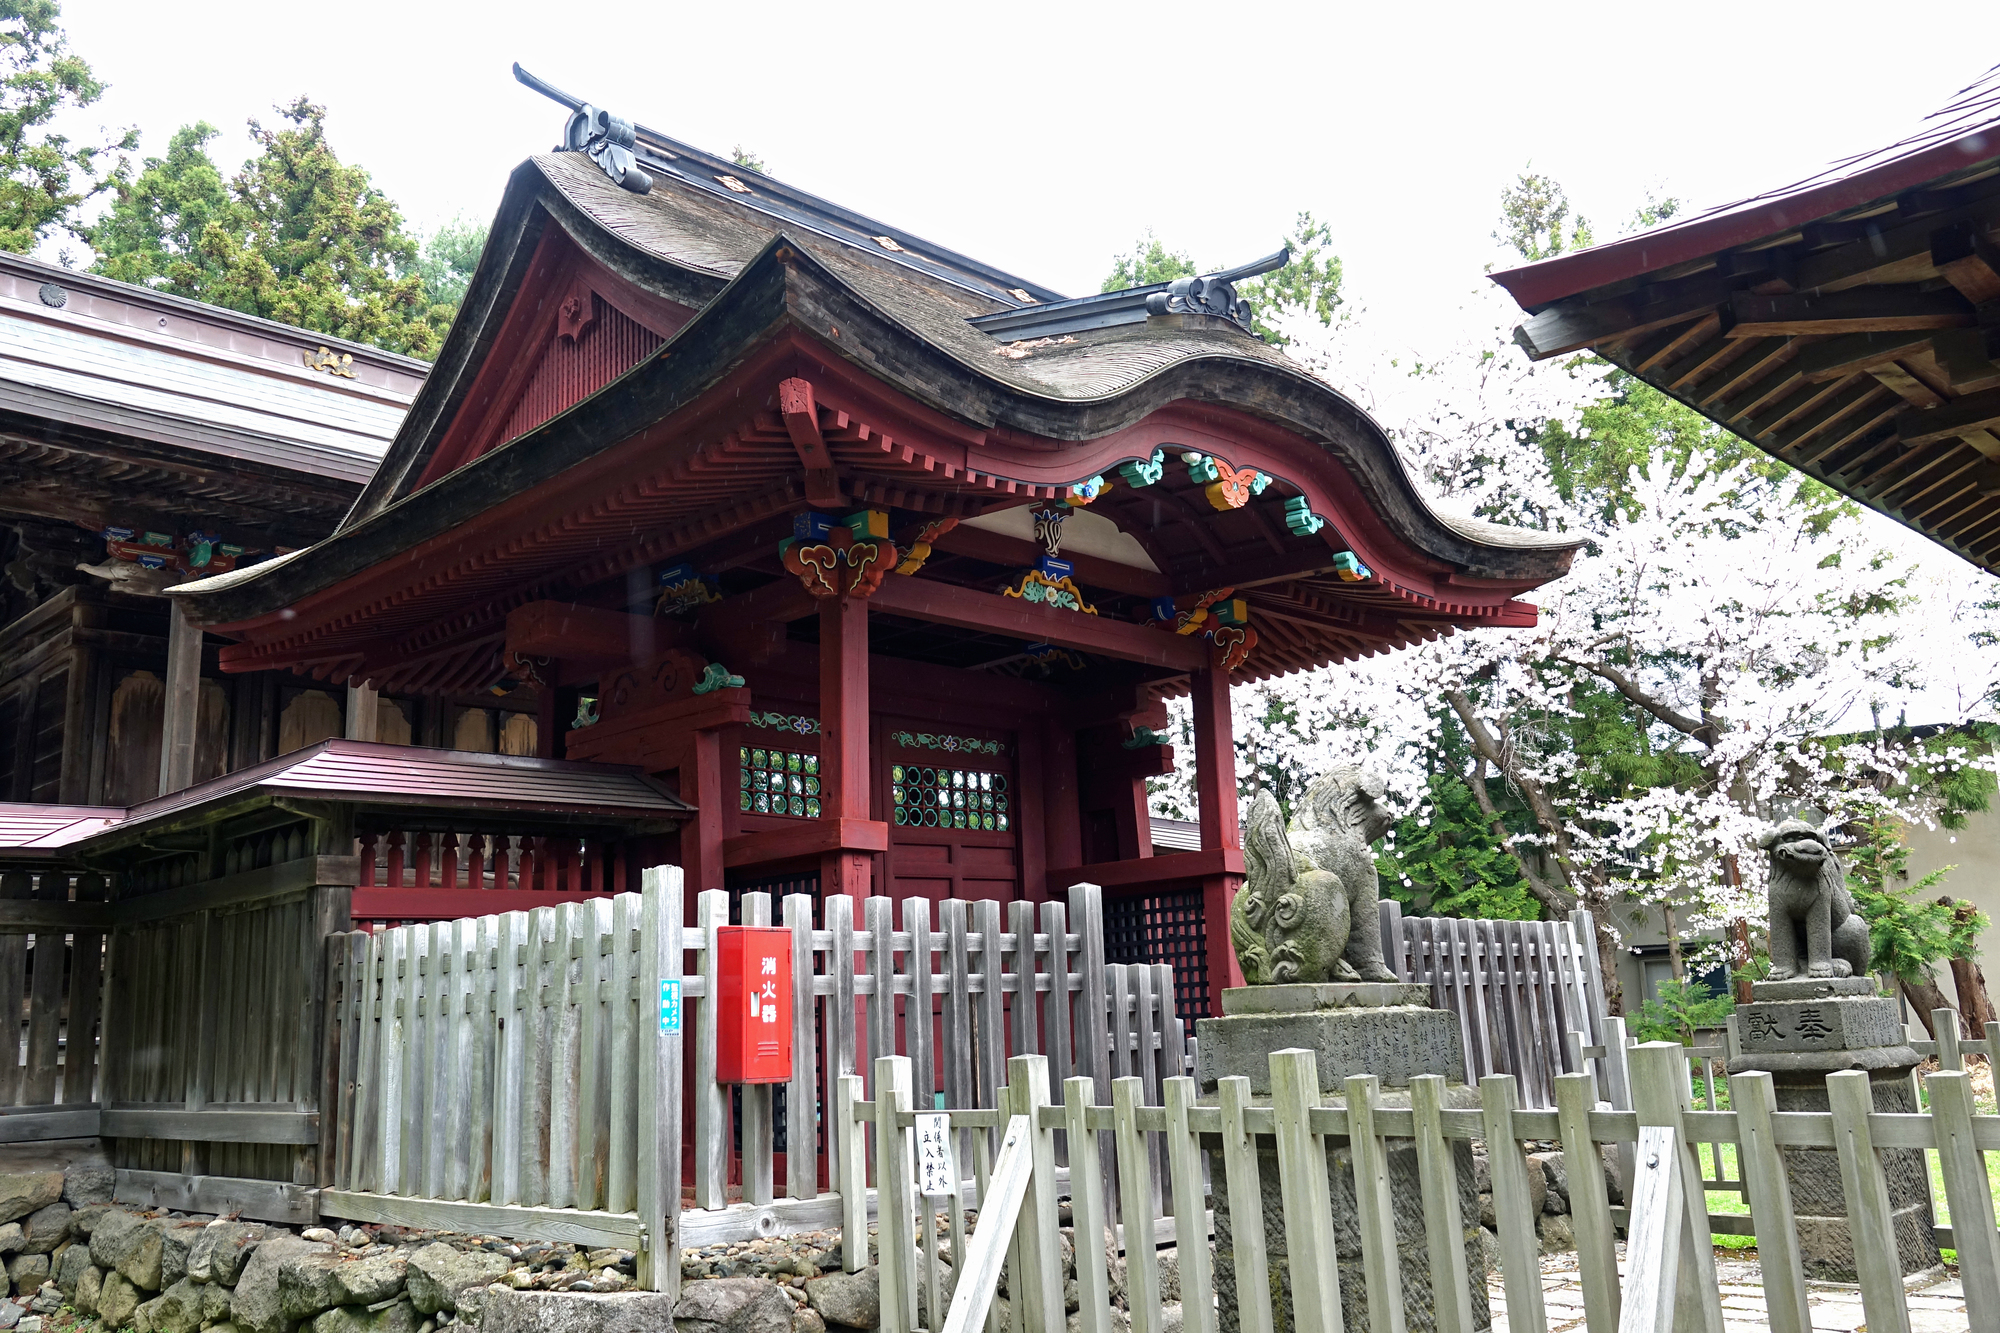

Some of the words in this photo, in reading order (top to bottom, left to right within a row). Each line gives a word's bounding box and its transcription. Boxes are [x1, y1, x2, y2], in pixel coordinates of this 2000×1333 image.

[662, 982, 670, 1025] 作動中
[670, 982, 679, 1026] 監視カメラ
[761, 956, 777, 1023] 消火器
[923, 1130, 935, 1191] 立入禁止
[933, 1116, 948, 1188] 関係者以外
